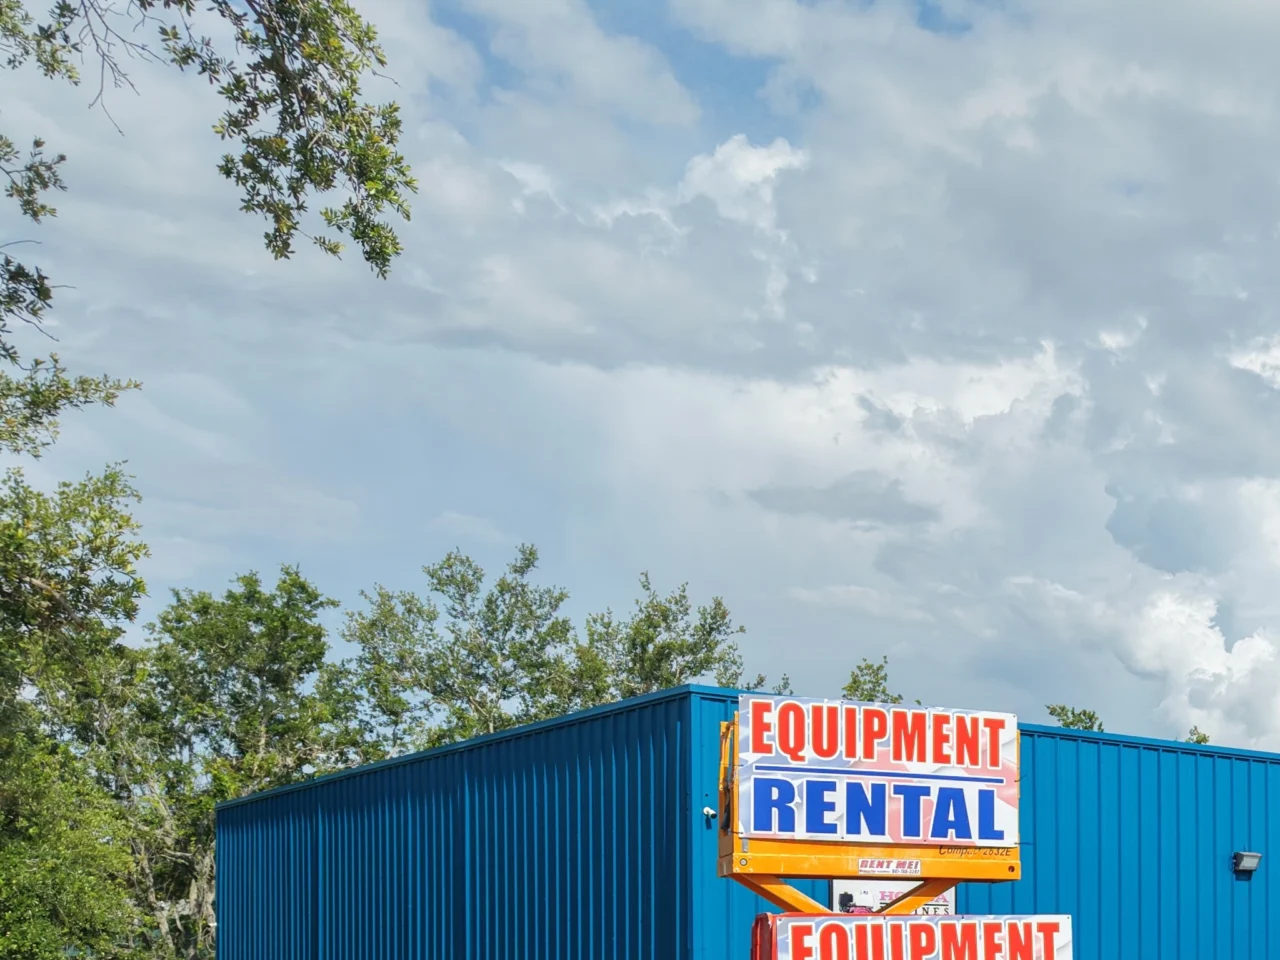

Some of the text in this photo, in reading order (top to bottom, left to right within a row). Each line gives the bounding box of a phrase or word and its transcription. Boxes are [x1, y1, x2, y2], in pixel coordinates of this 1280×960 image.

[750, 702, 1005, 768] EQUIPMENT
[753, 777, 1005, 840] RENTAL
[860, 860, 893, 869] RENT
